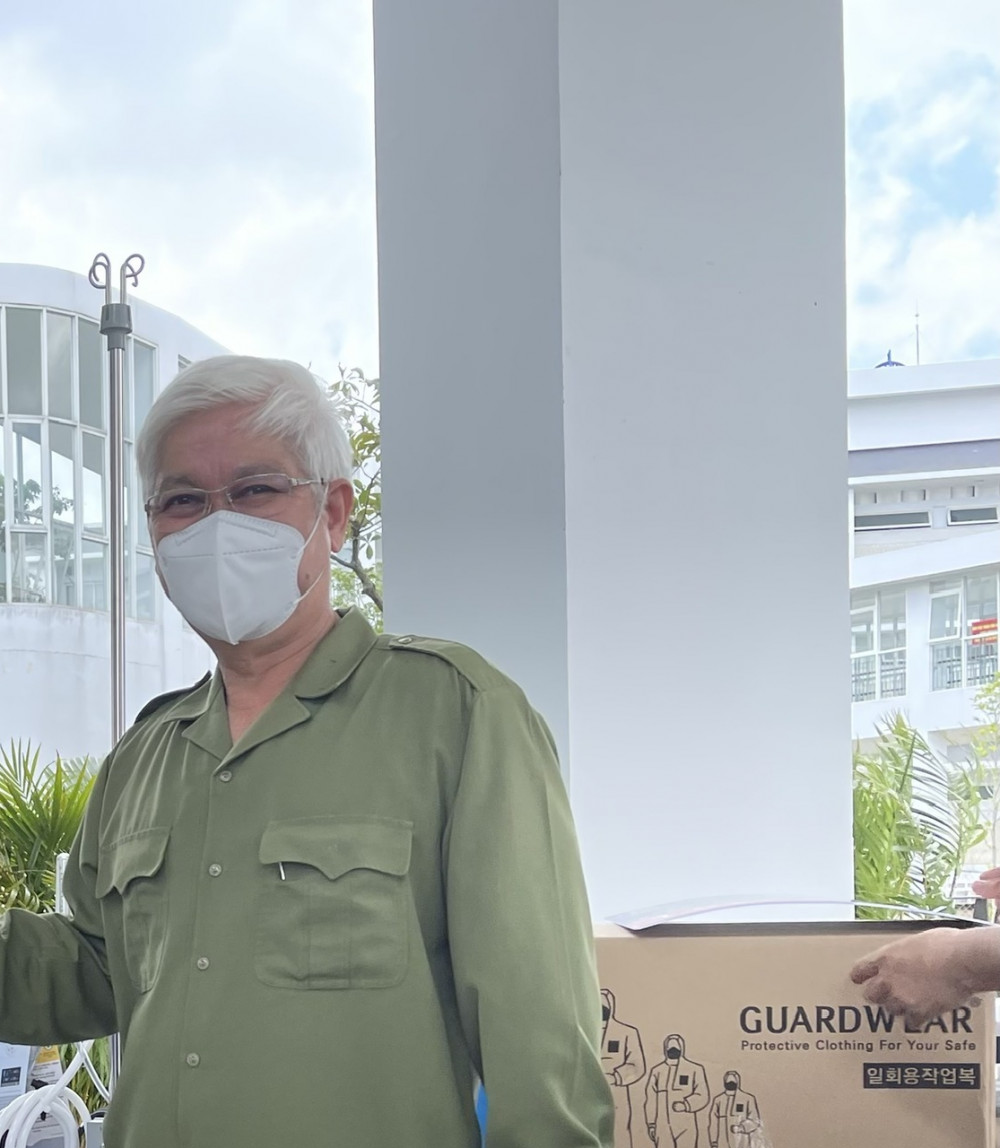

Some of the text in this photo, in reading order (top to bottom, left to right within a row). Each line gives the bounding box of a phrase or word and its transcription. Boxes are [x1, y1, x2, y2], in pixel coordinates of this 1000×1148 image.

[741, 1039, 977, 1053] Protective Clothing For Your Safe
[866, 1067, 977, 1085] 일회용작업복
